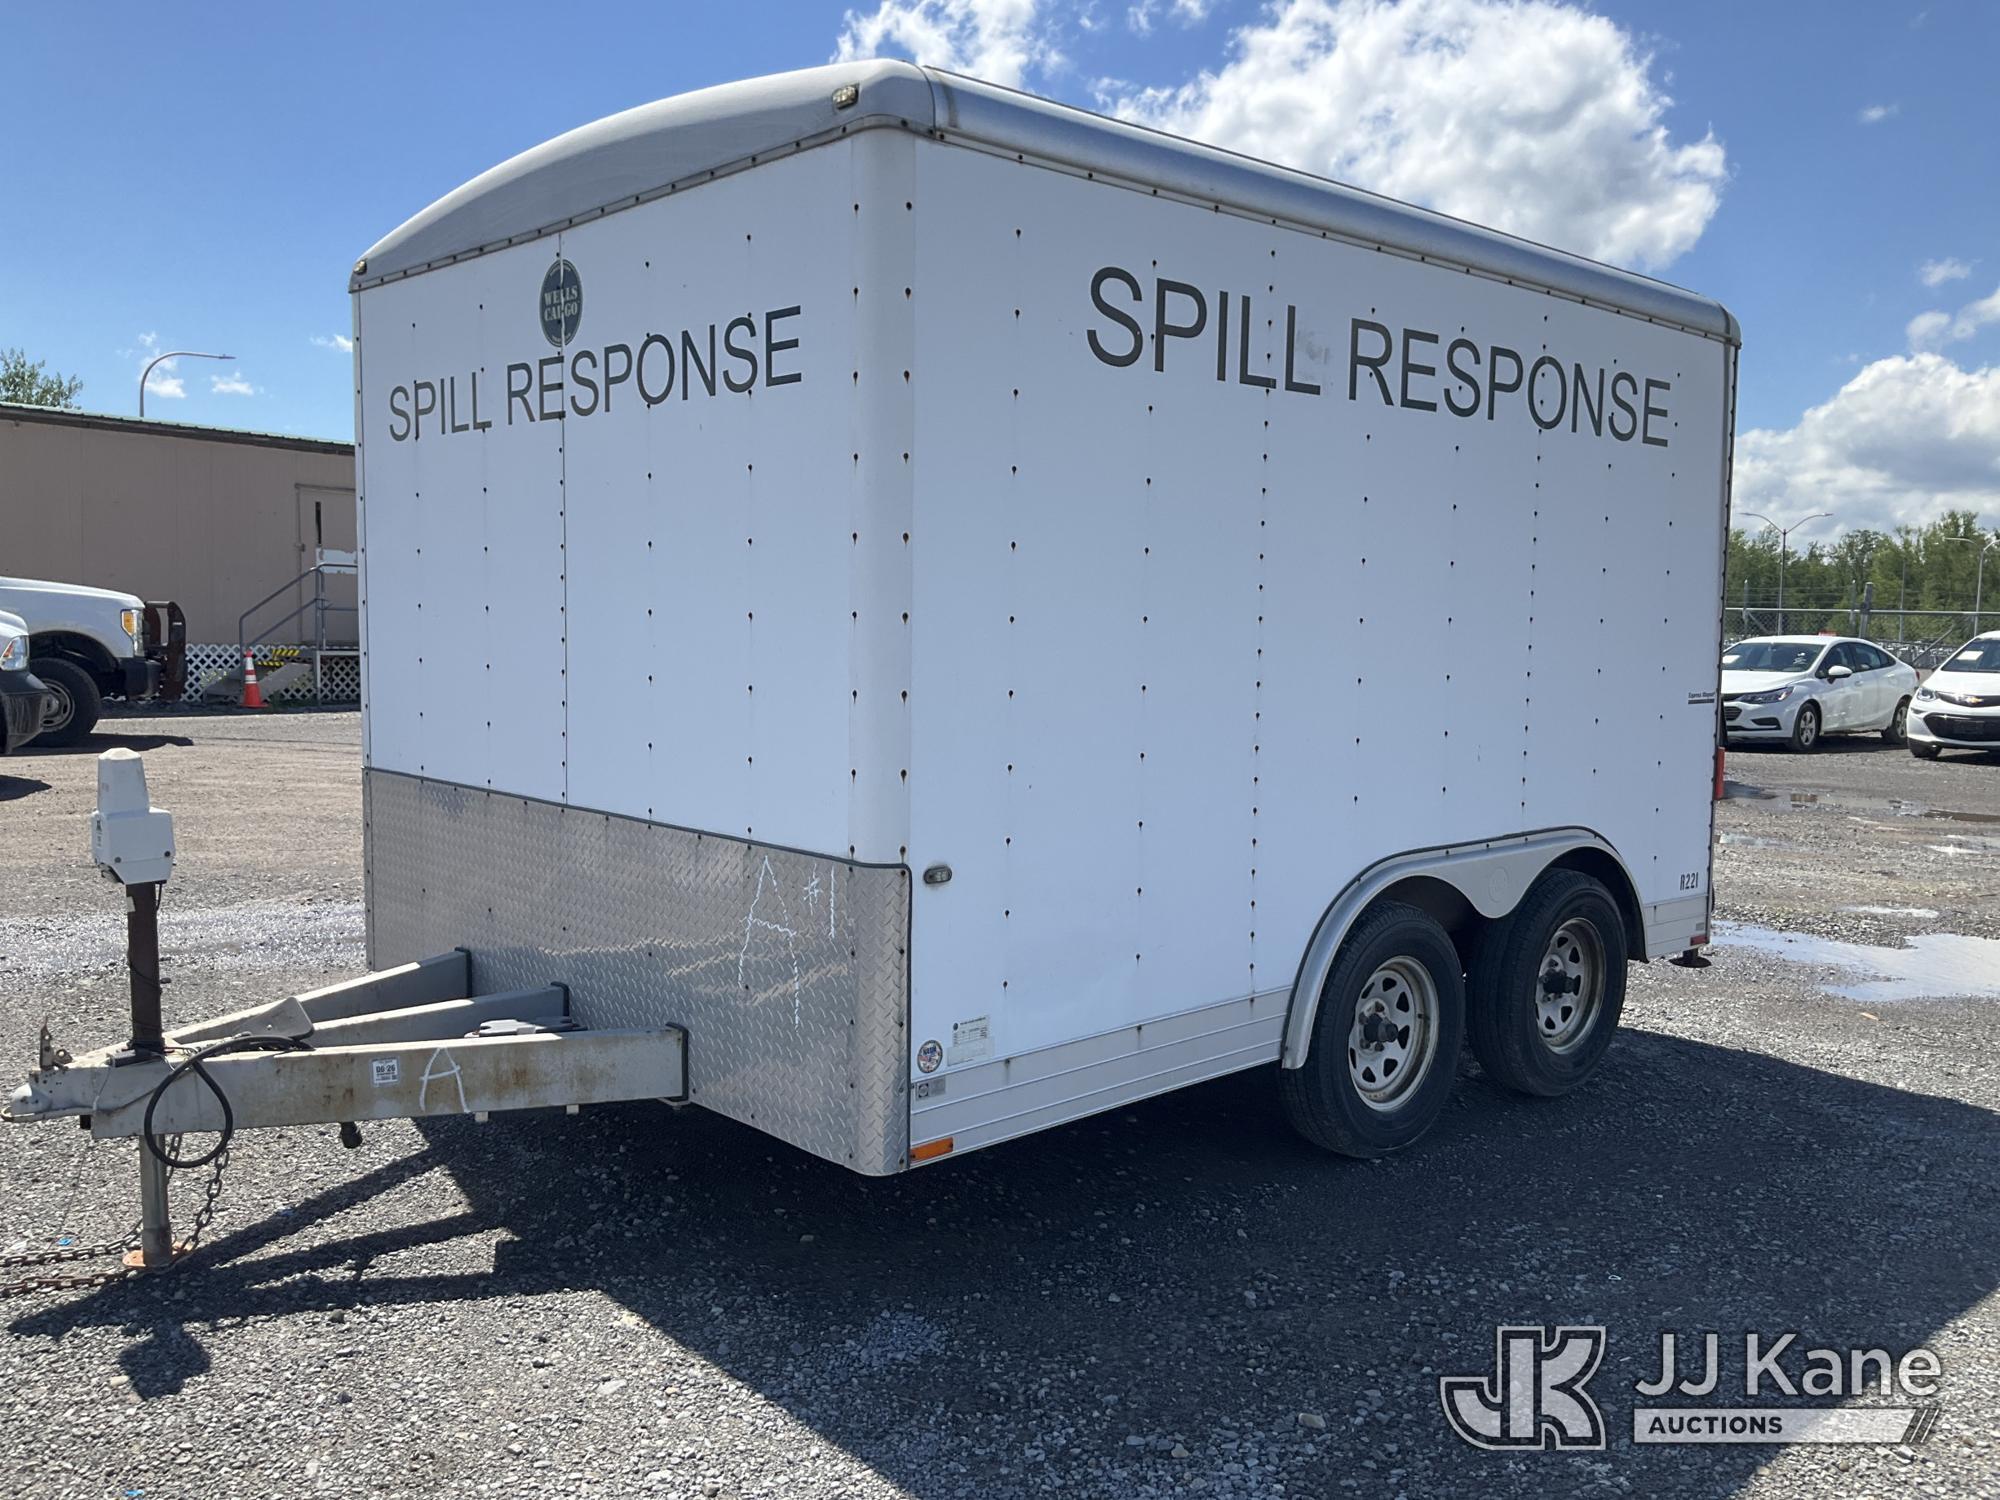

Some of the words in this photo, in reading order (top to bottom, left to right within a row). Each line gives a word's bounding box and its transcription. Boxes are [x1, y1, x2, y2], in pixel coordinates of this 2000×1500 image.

[389, 371, 492, 442] SPILL
[506, 305, 802, 425] RESPONSE
[1086, 266, 1321, 396] SPILL
[1347, 317, 1672, 448] RESPONSE
